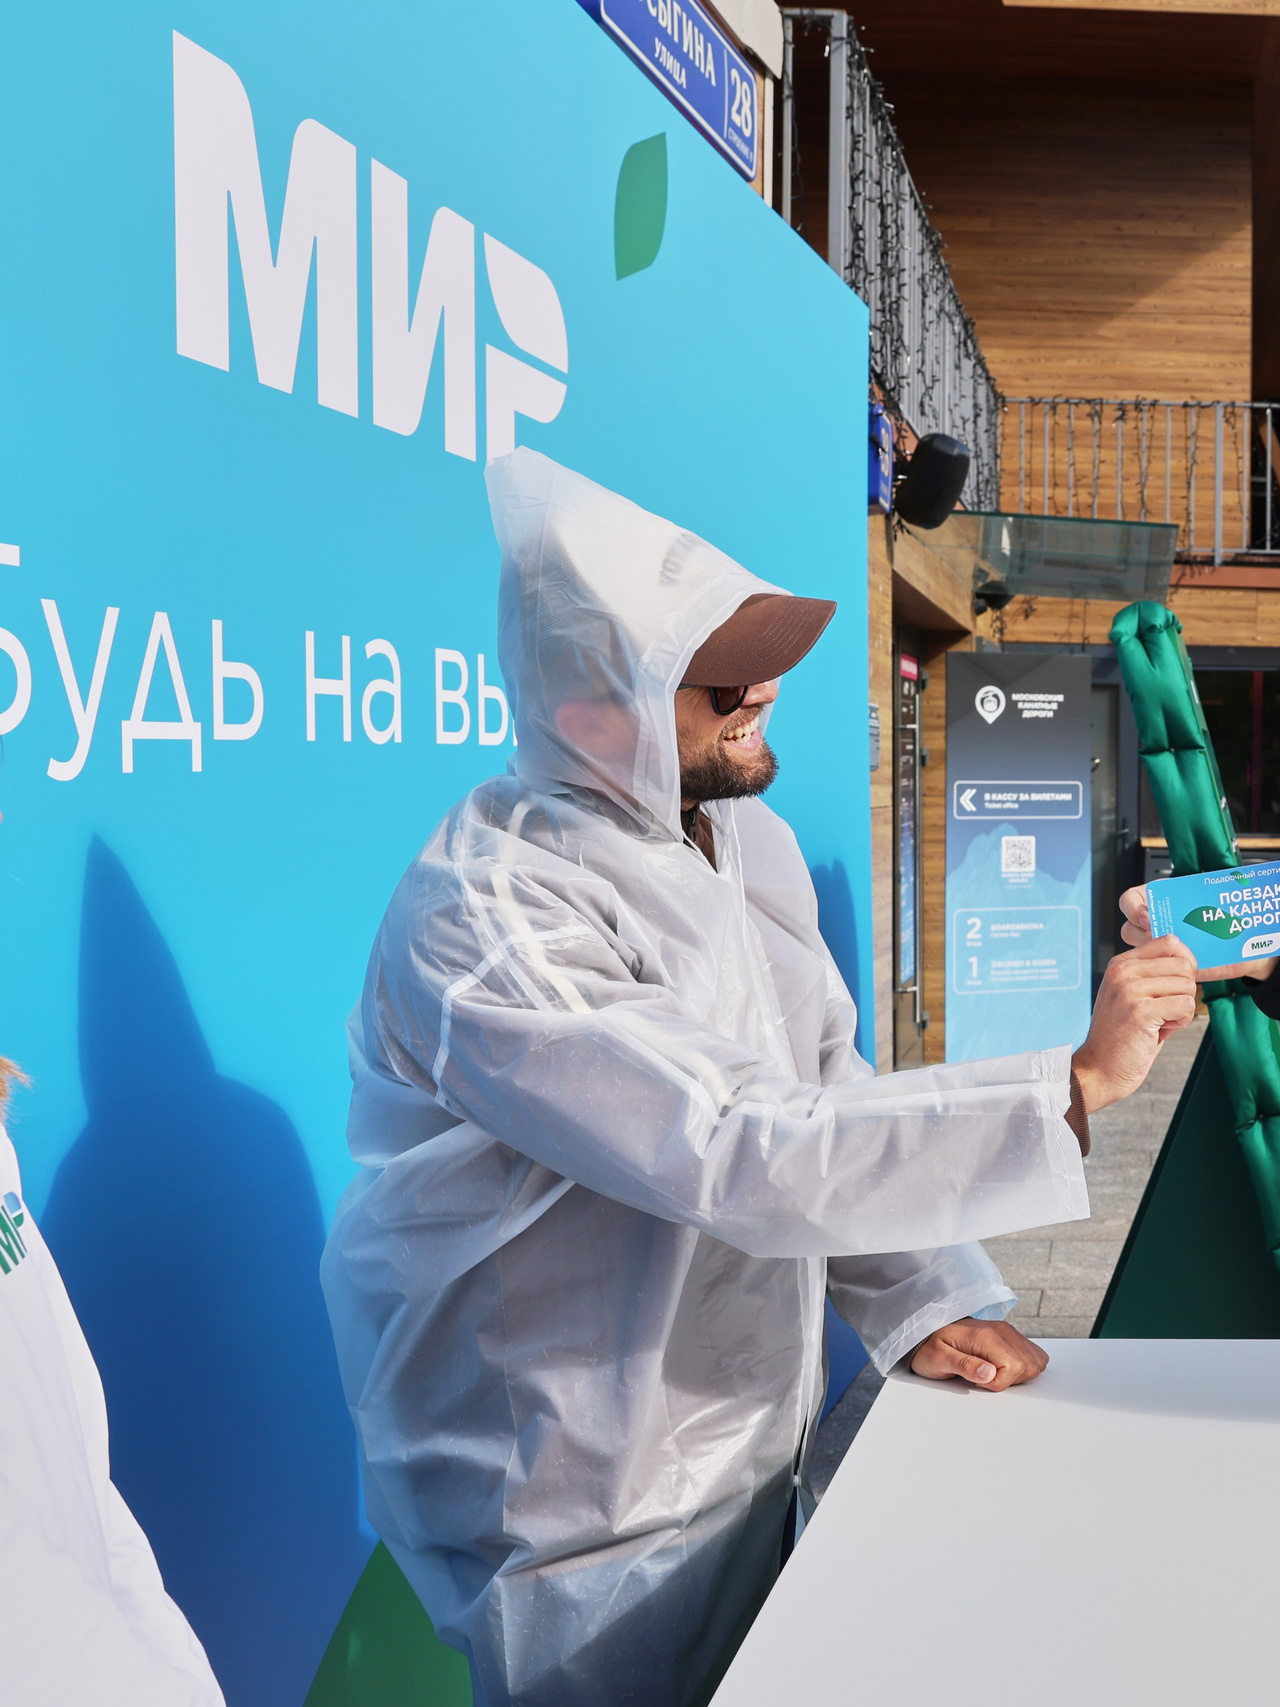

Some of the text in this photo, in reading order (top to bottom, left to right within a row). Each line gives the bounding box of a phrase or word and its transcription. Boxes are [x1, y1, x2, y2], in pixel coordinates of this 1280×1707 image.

[654, 37, 687, 89] УЛИЦА
[731, 68, 752, 138] 28
[172, 29, 569, 462] МИР
[305, 630, 402, 745] на
[1021, 710, 1054, 718] ДОРОГИ
[984, 793, 1073, 801] В КАССУ ЗА БИЛЕТАМИ
[1204, 870, 1256, 885] Подарочный
[1202, 908, 1226, 922] НА
[966, 917, 982, 940] 2
[1251, 939, 1274, 950] МИР
[968, 956, 979, 978] 1
[0, 1191, 28, 1275] МР
